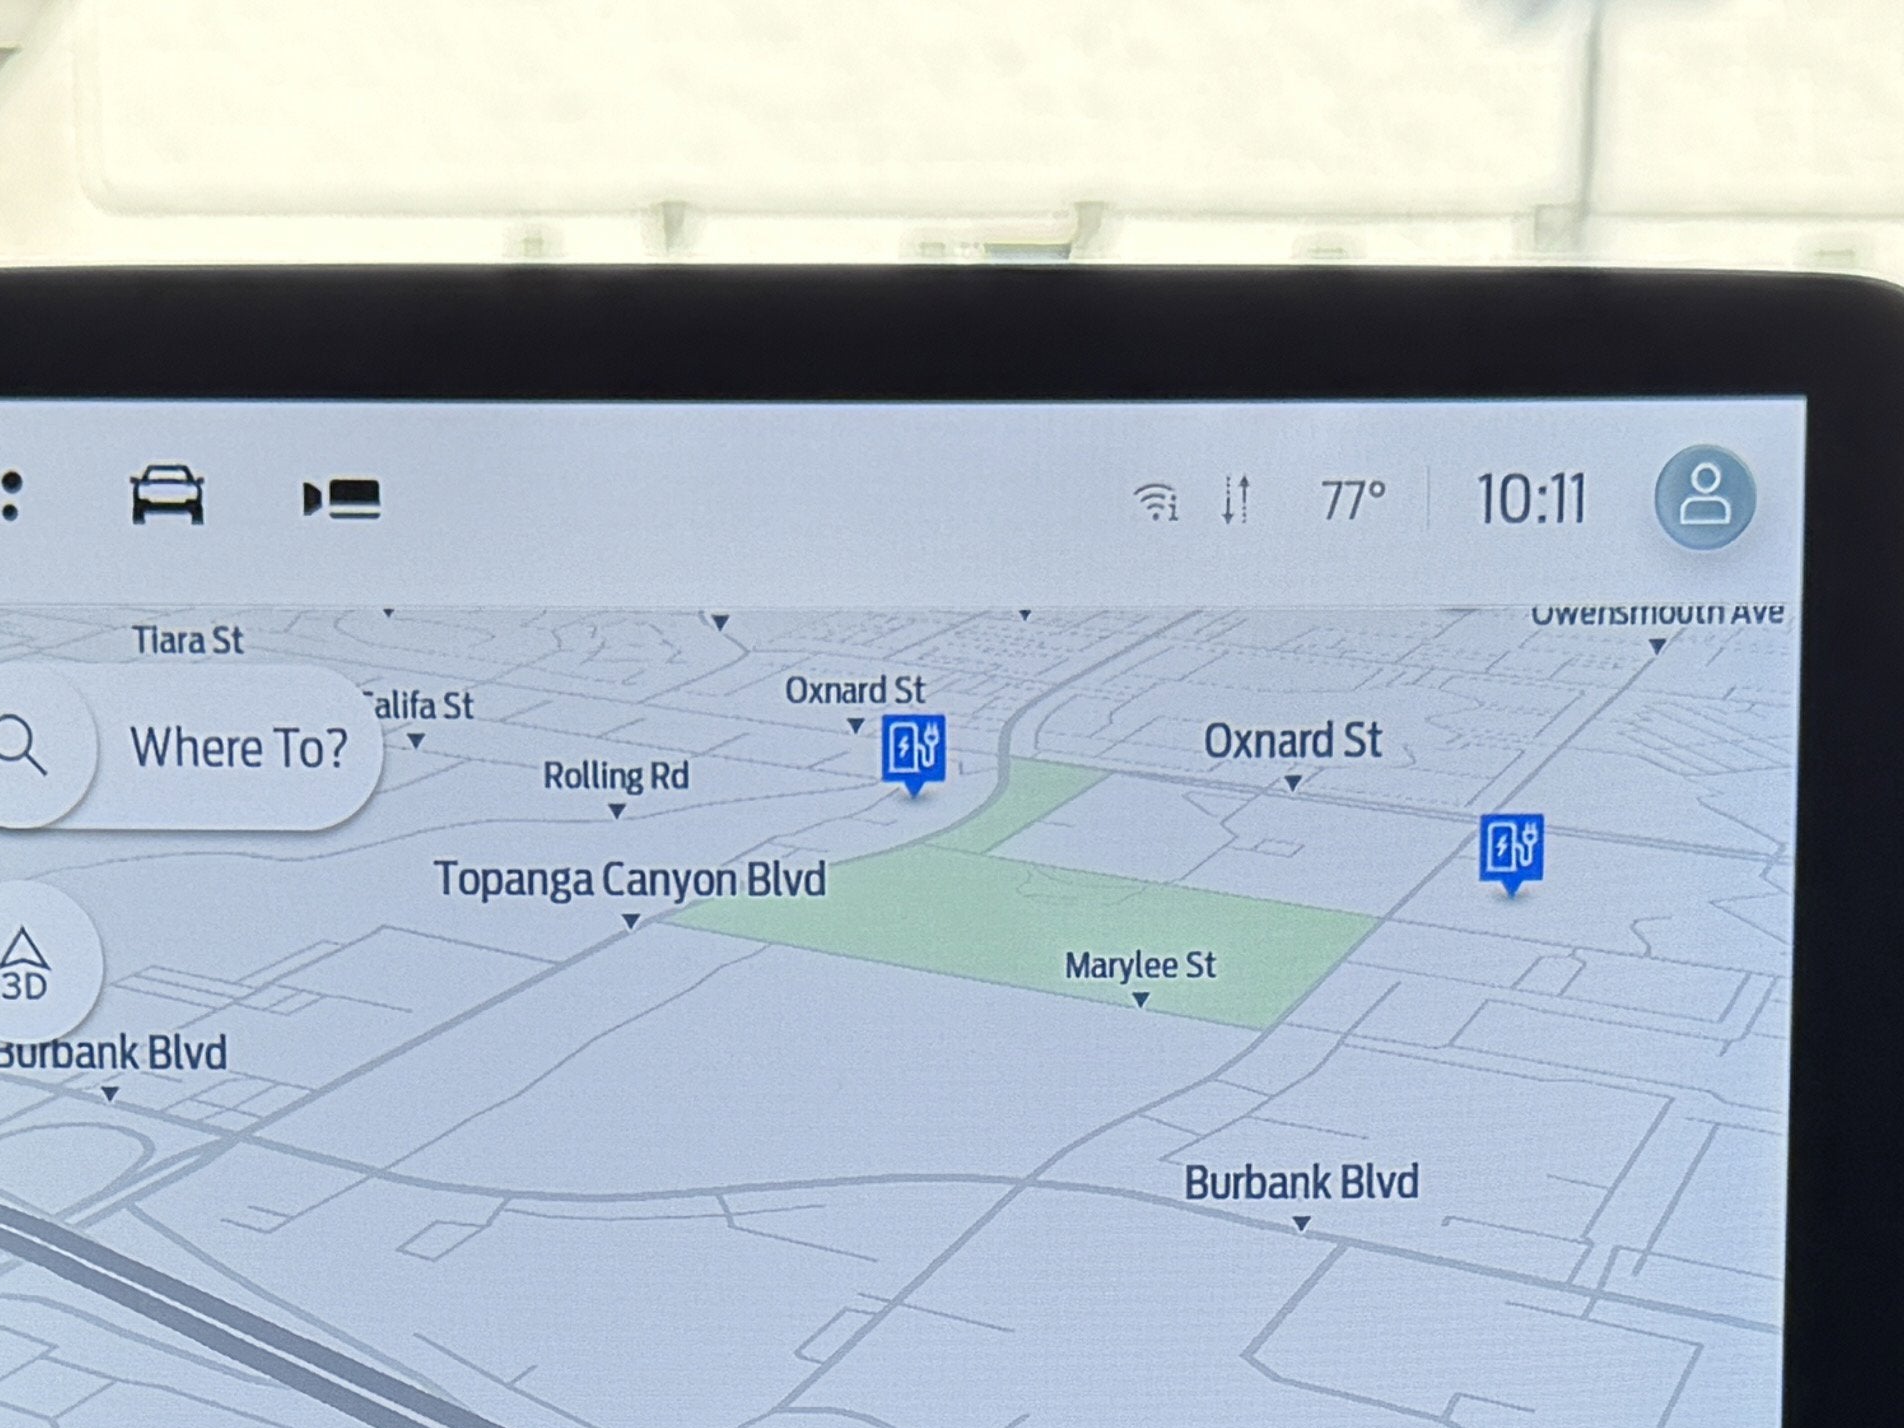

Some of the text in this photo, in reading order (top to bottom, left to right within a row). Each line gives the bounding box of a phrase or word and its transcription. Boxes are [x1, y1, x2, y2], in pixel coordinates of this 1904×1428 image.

[1321, 480, 1386, 520] 77°
[1479, 472, 1585, 524] 10:11
[212, 625, 244, 655] St
[361, 689, 474, 720] alifa St
[785, 675, 926, 704] Oxnard St
[130, 724, 348, 769] Where To?
[1205, 719, 1383, 759] Oxnard St
[544, 759, 689, 796] Rolling Rd
[433, 859, 826, 905] Topanga Canyon Blvd
[1, 970, 48, 1001] 3D
[1066, 949, 1217, 986] Marylee St
[148, 1032, 227, 1070] Blvd
[1186, 1161, 1419, 1200] Burbank Blvd
